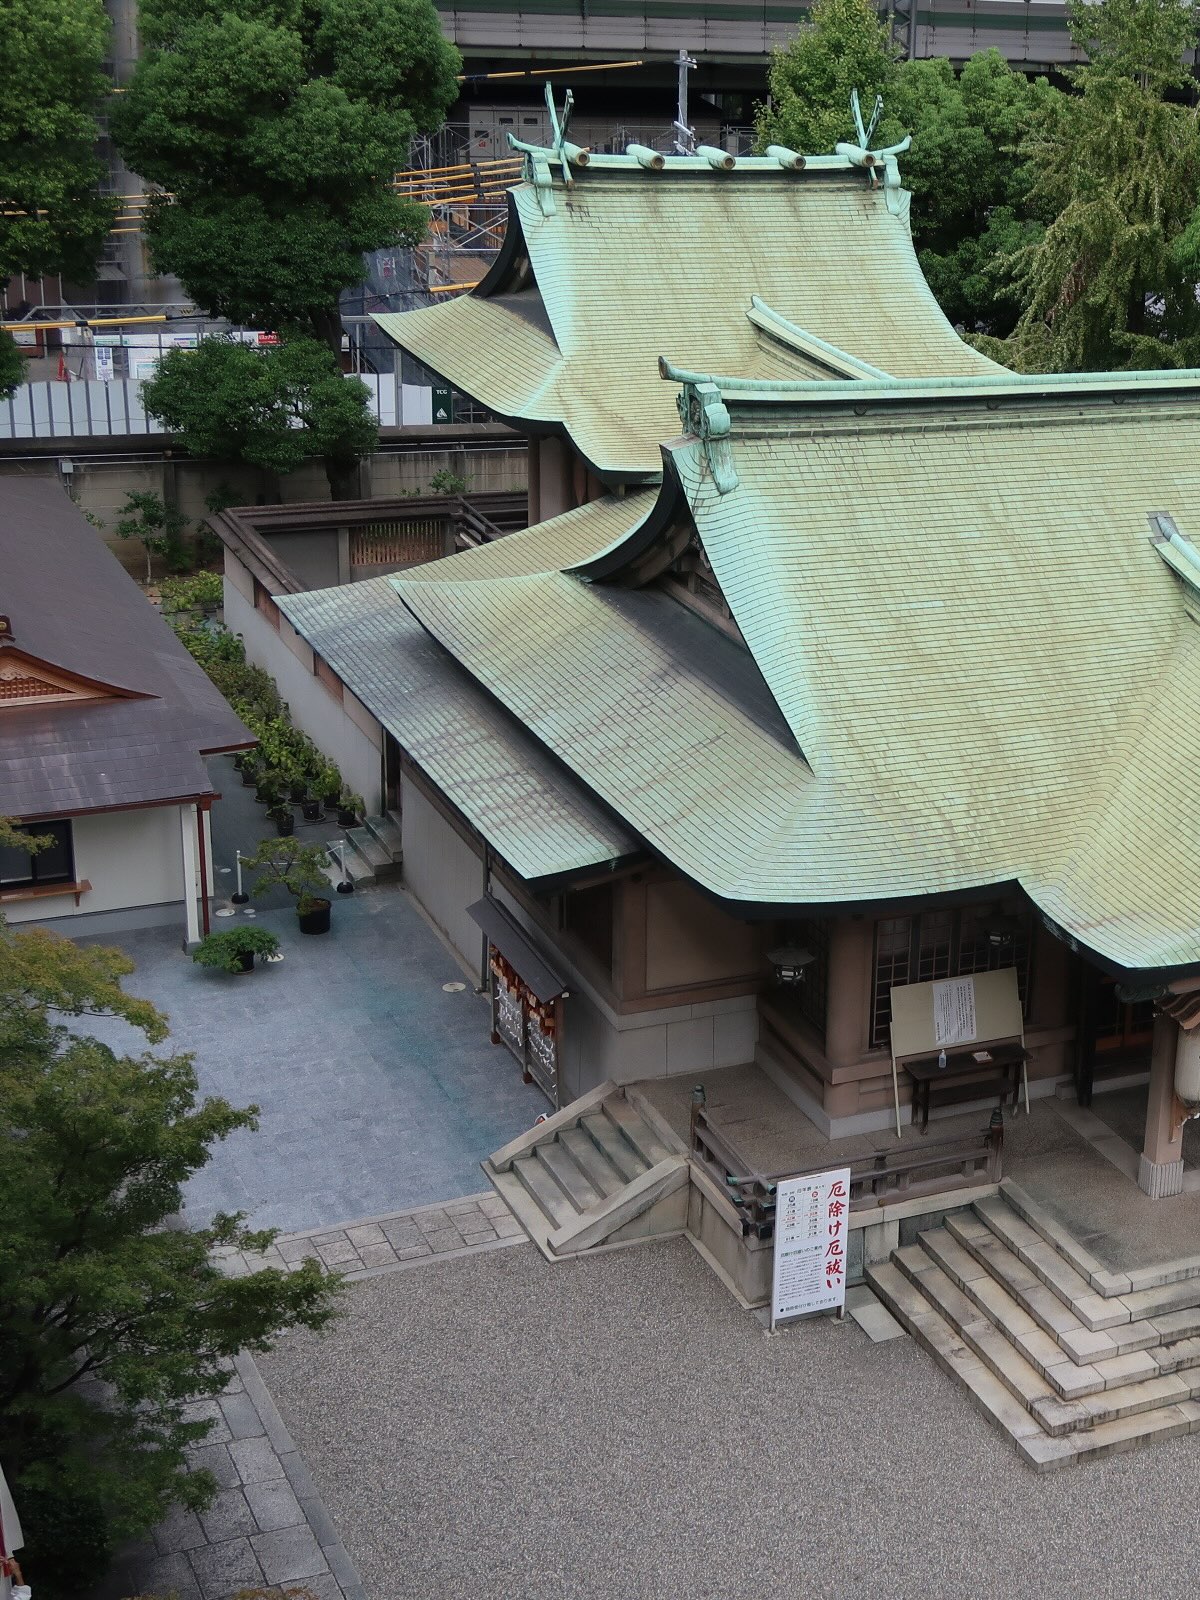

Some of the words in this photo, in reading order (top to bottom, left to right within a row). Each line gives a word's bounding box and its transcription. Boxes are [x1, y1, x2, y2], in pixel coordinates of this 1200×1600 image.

[825, 1180, 847, 1289] 厄除け厄祓い
